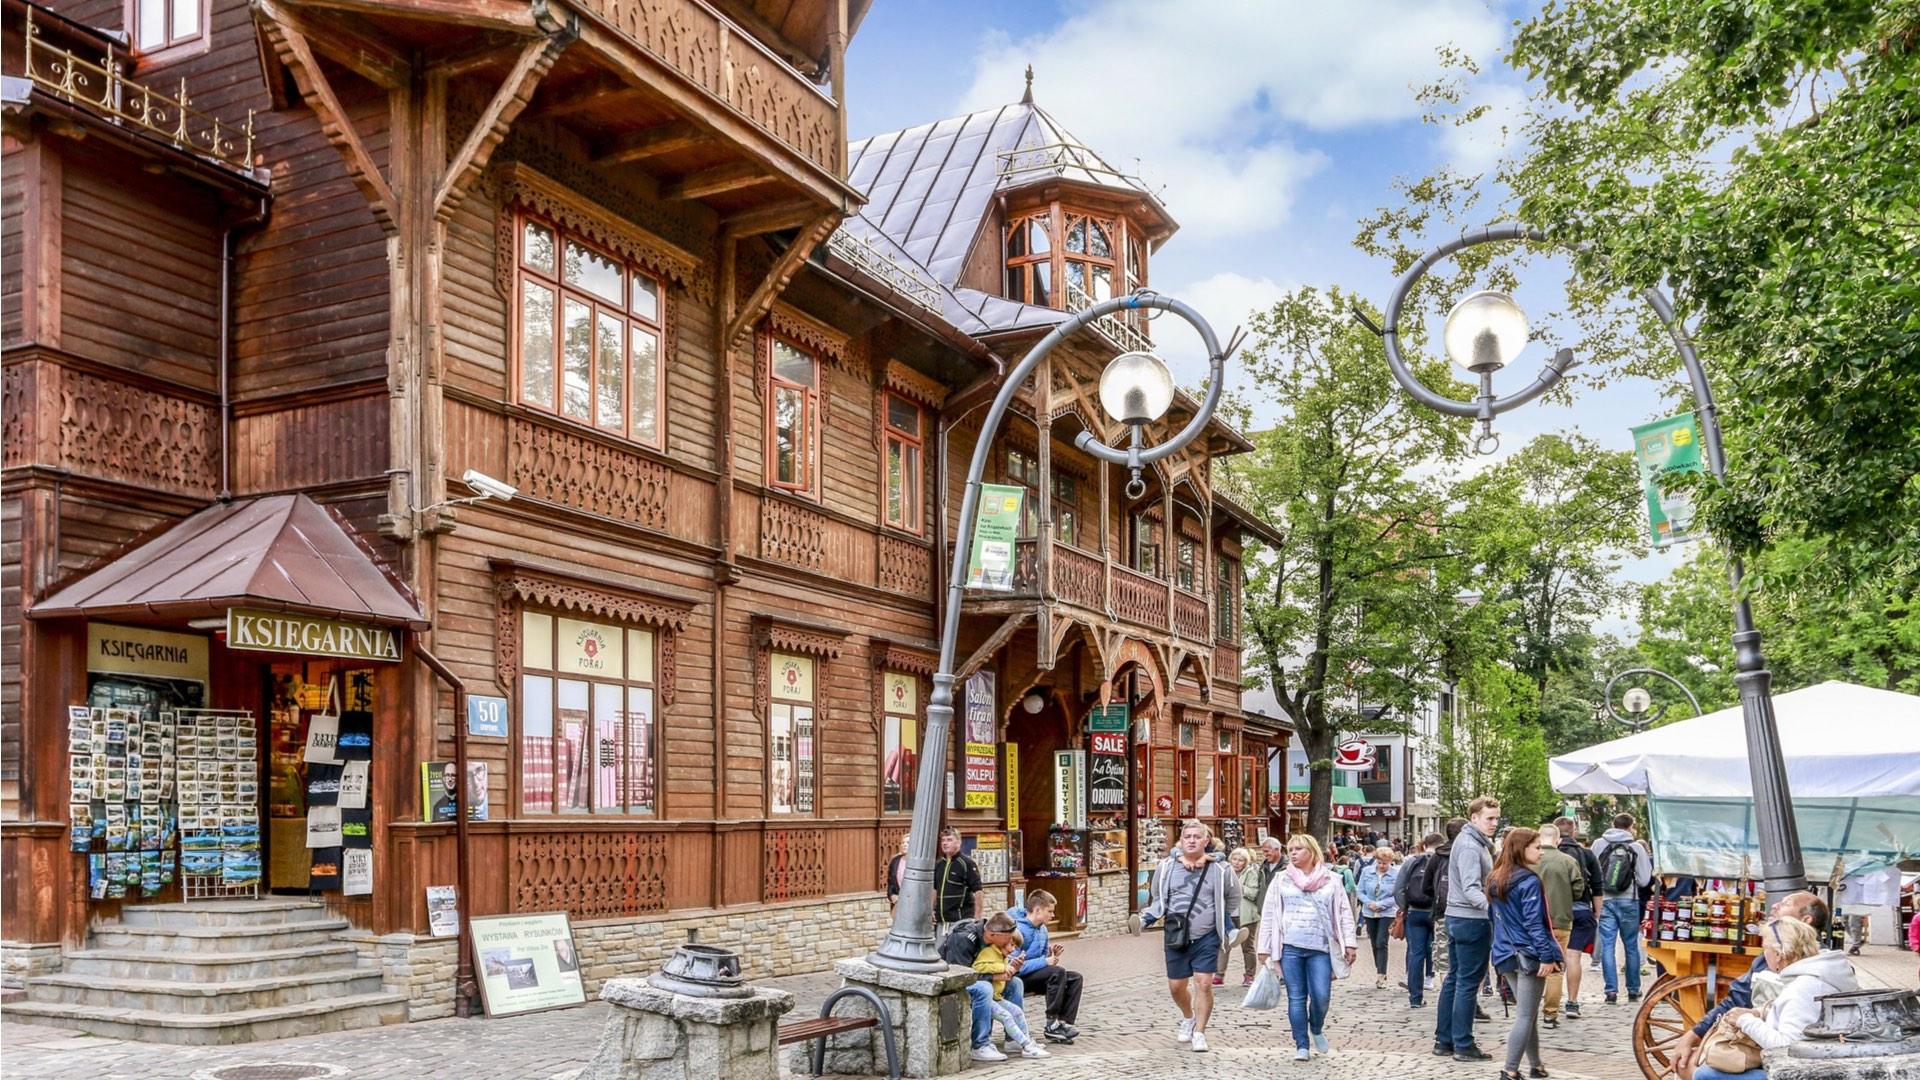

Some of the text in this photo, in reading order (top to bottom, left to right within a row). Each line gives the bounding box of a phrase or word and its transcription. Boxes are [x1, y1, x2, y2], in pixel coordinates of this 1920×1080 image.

[234, 614, 399, 659] KSIĘGARNIA
[100, 638, 188, 664] KSIĘGARNIA
[578, 658, 604, 670] PORAJ
[969, 688, 993, 706] Salon
[478, 700, 499, 723] 50
[969, 706, 993, 724] firan
[1094, 736, 1124, 753] SALE
[966, 768, 995, 781] SKLEPU
[1061, 769, 1070, 826] DENTYSTA
[1092, 788, 1125, 805] OBUWIE
[480, 927, 564, 942] WYSTAWA RYSUNKÓW
